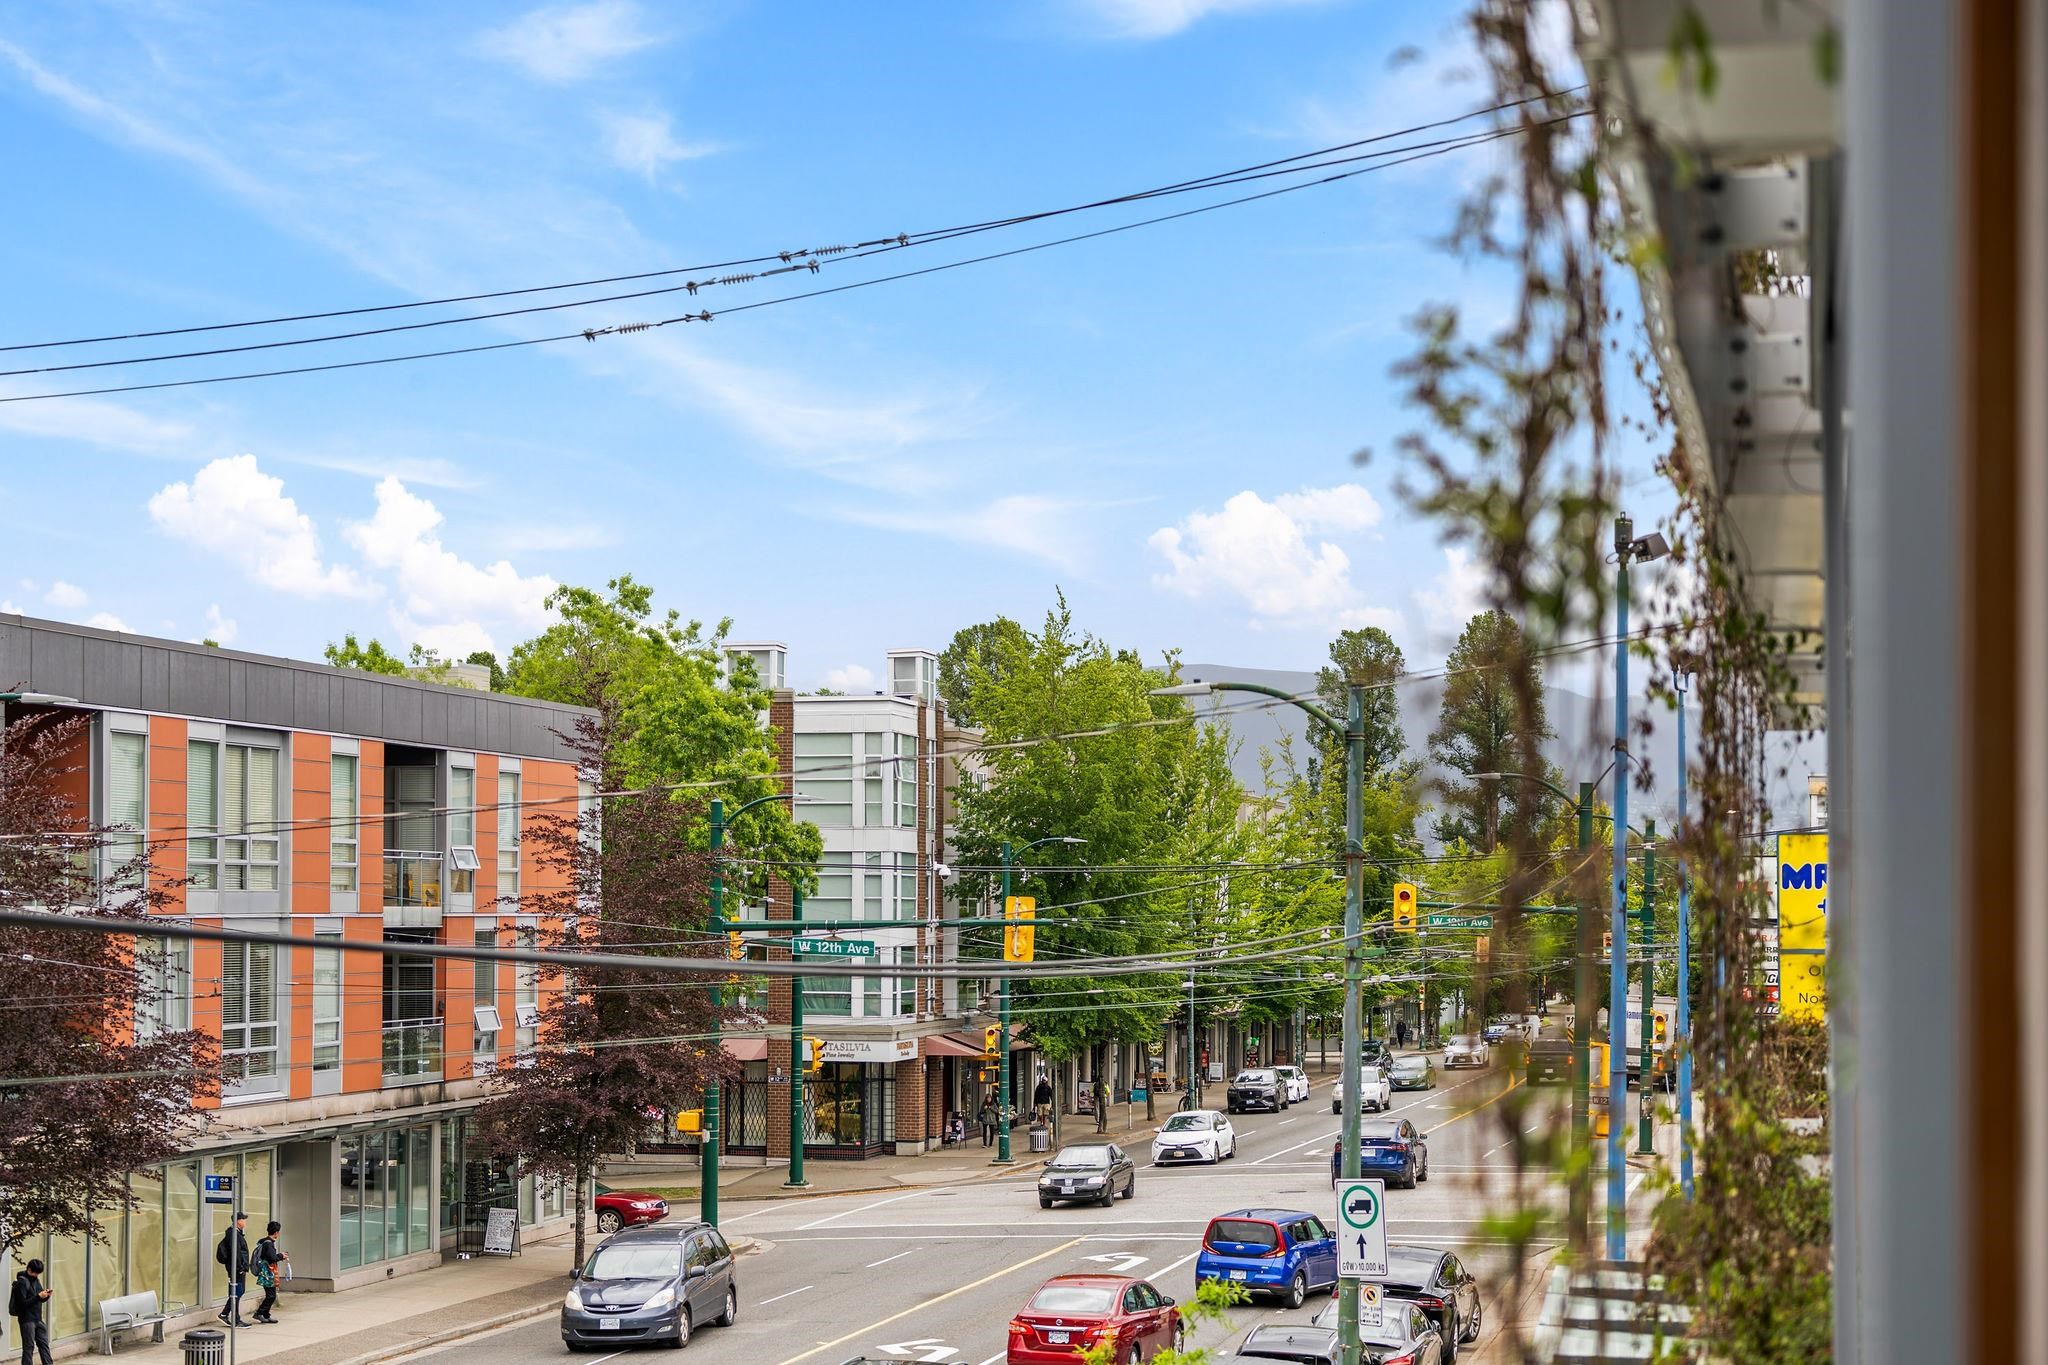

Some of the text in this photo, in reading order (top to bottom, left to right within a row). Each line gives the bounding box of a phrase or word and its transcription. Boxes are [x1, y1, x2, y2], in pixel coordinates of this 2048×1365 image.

[1432, 917, 1443, 925] W
[1470, 918, 1489, 927] Ave
[798, 940, 870, 954] W 12th Ave
[207, 1177, 216, 1189] T
